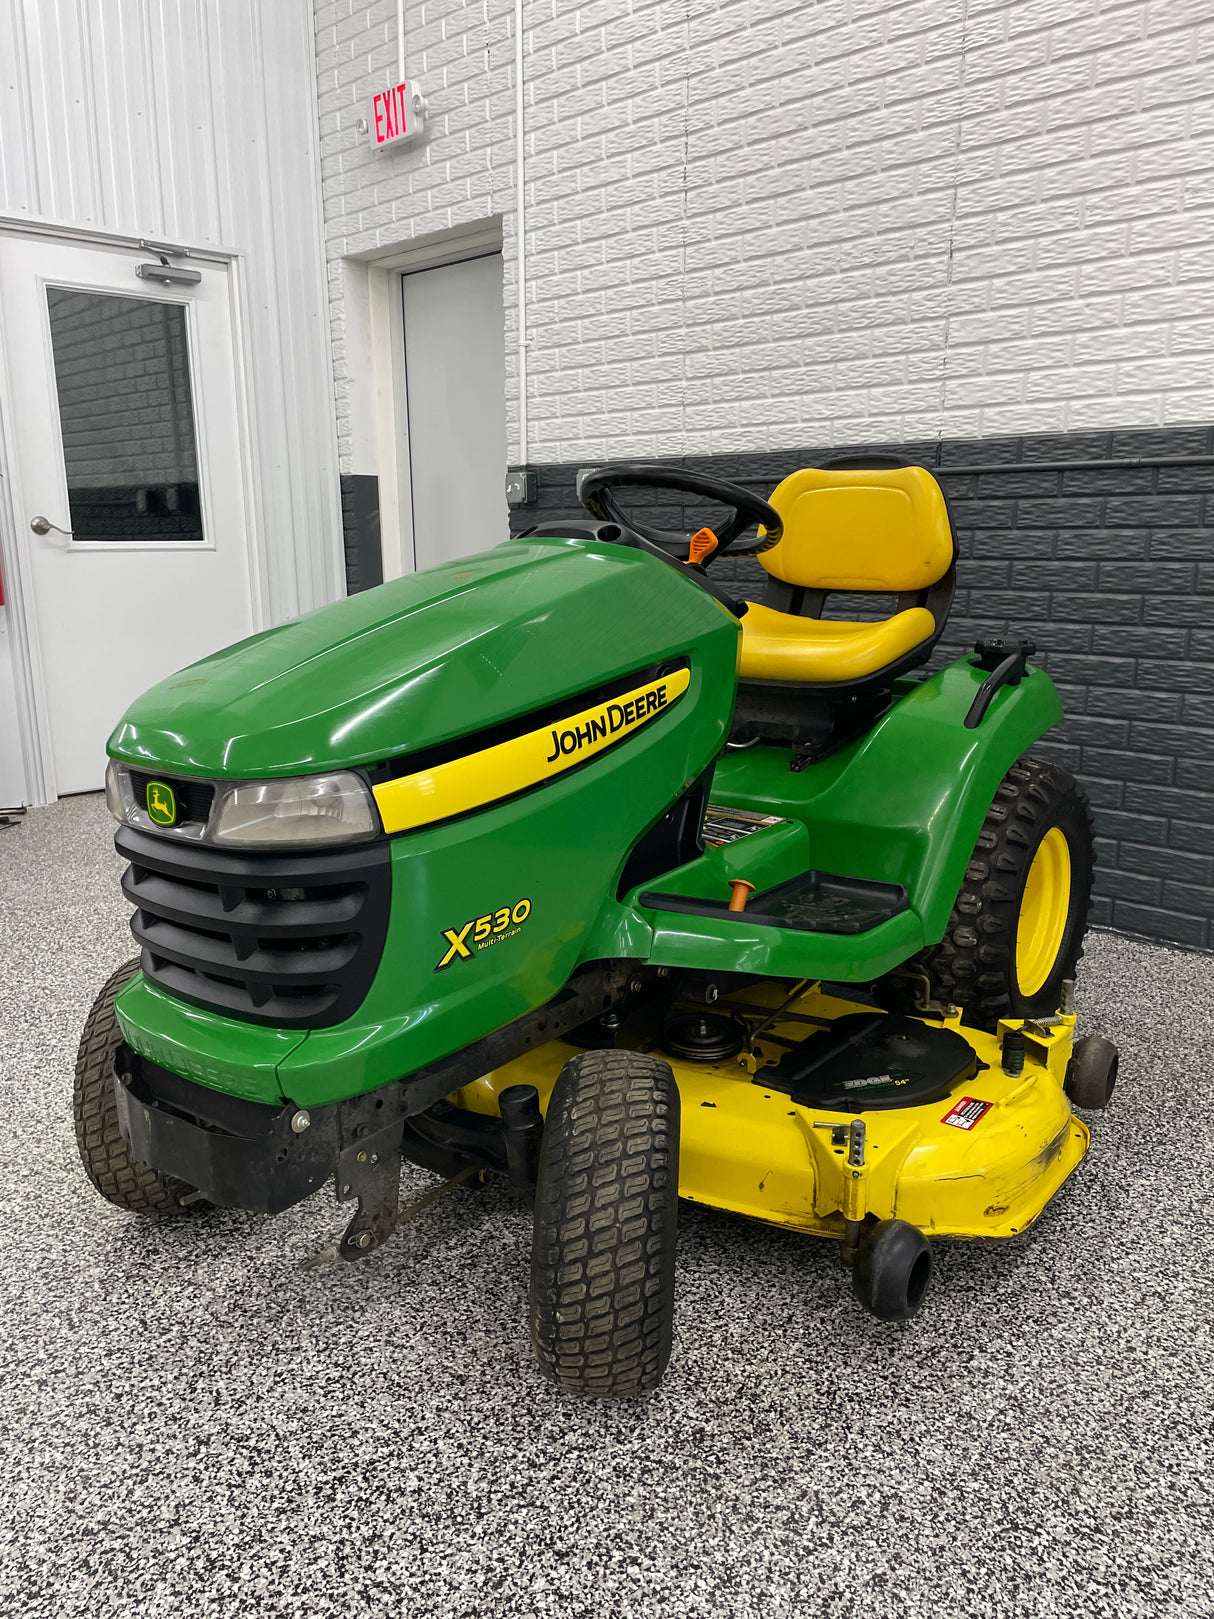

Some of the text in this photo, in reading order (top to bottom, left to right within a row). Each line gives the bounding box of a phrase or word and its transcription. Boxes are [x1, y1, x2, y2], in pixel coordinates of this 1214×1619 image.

[373, 83, 406, 143] EXIT
[547, 685, 667, 763] JOHN DEERE
[434, 898, 531, 972] X530
[477, 927, 521, 950] Multi-Terrain
[842, 1075, 893, 1089] EDGE
